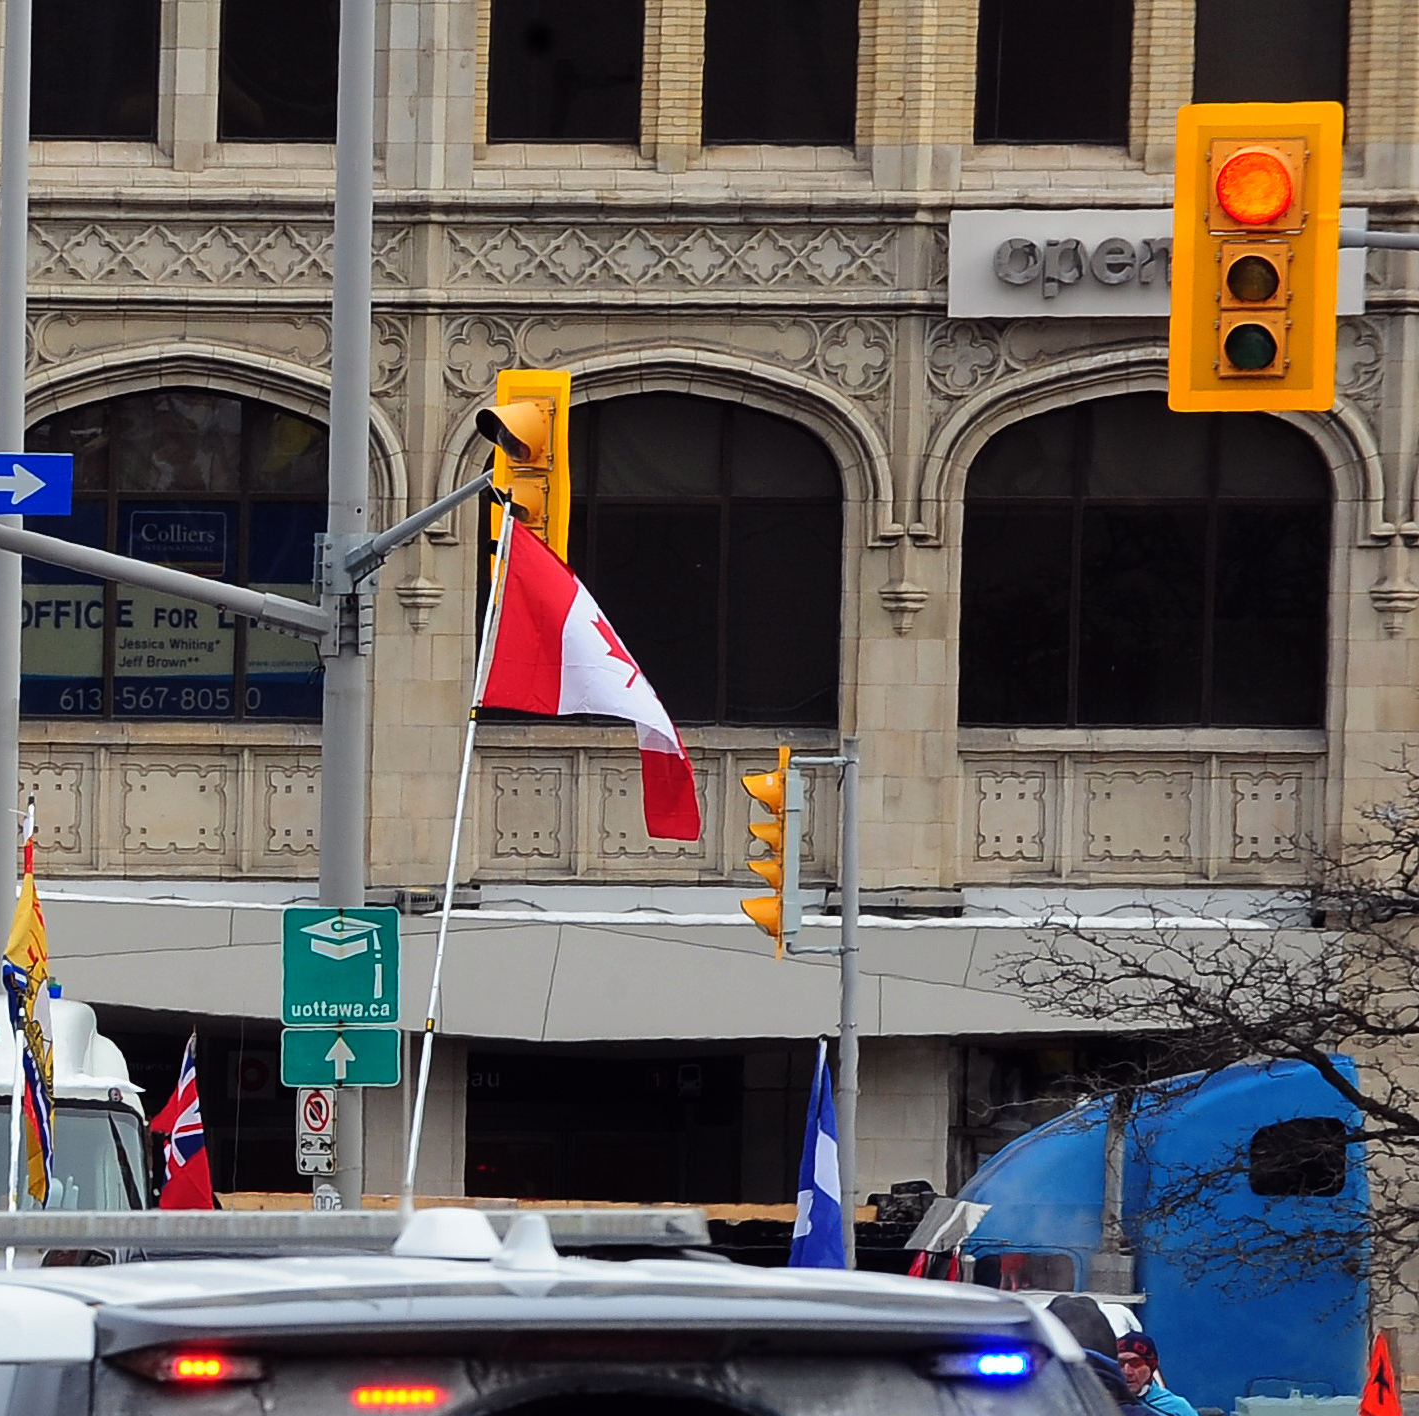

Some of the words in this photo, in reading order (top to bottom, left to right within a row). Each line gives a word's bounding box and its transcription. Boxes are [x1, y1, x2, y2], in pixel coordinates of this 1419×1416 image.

[994, 233, 1173, 300] open
[140, 523, 215, 544] Colliers
[153, 608, 198, 630] FOR
[118, 638, 165, 651] Jessica
[118, 655, 143, 668] Jeff
[290, 1000, 391, 1018] uottawa.ca
